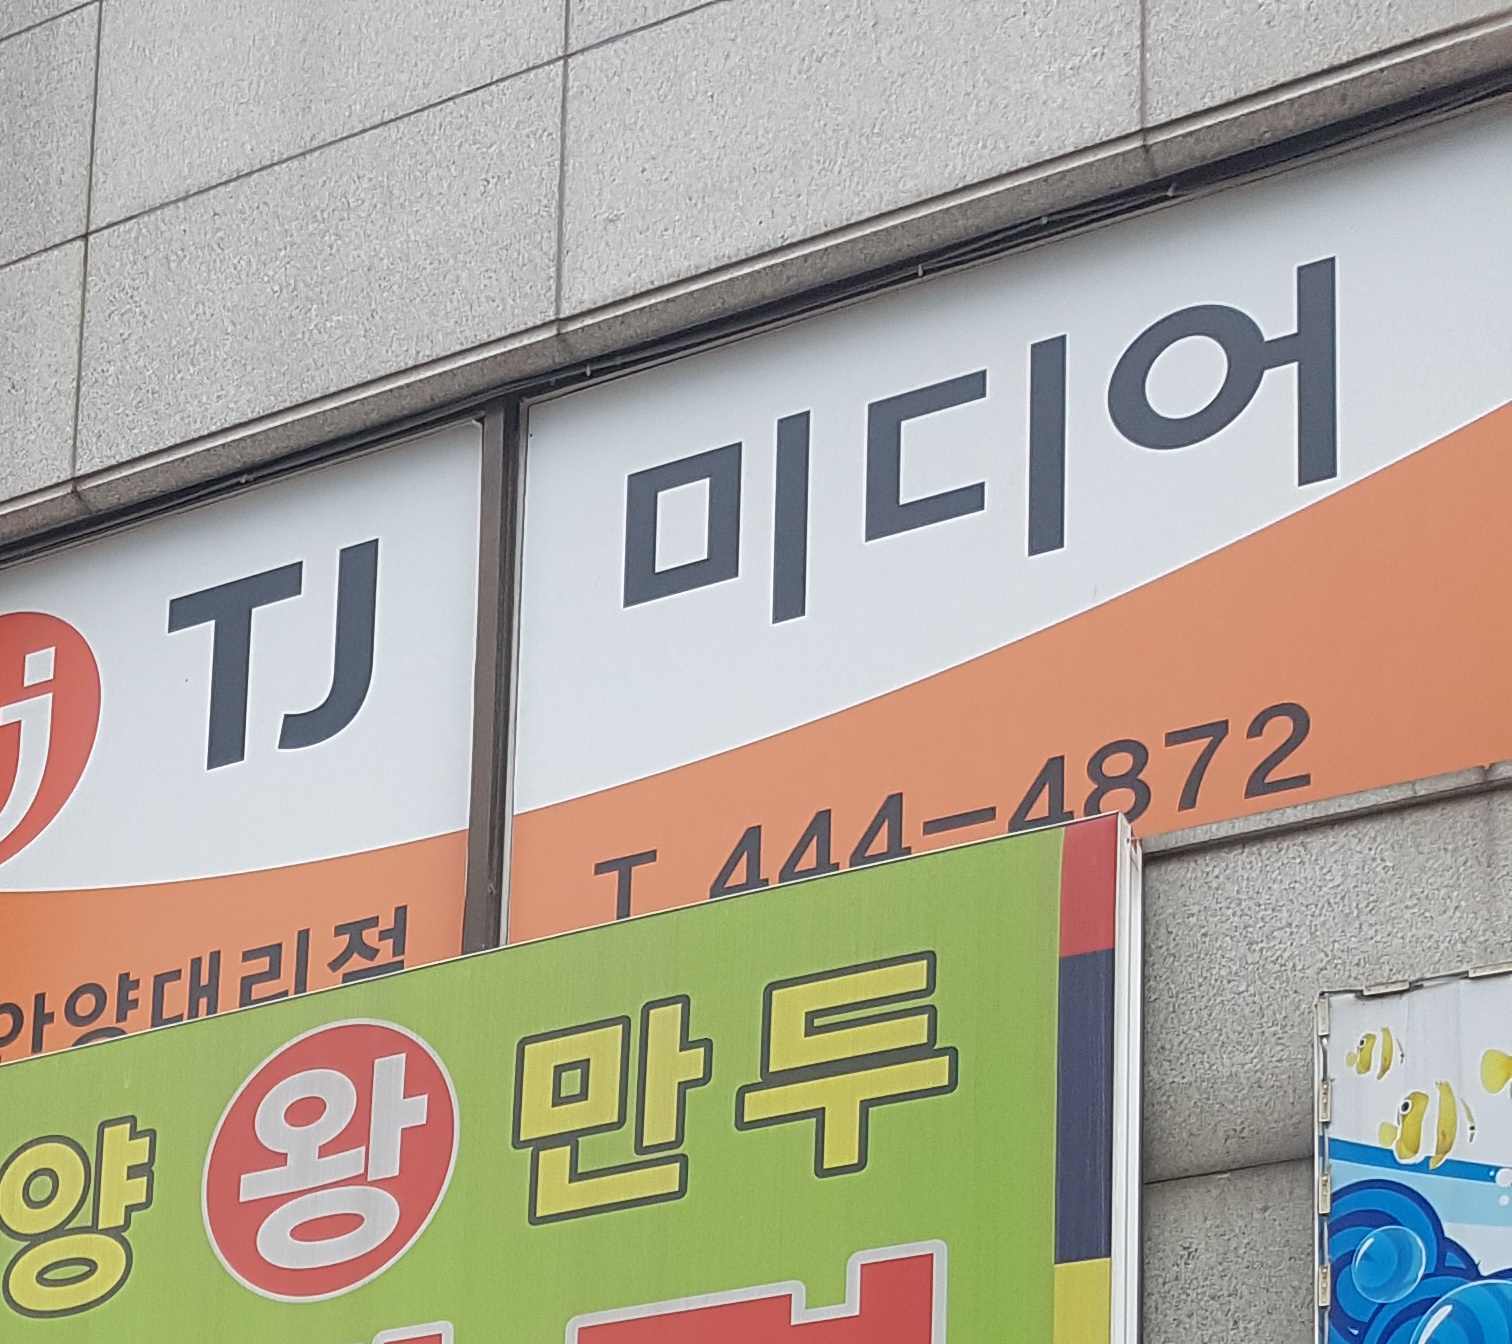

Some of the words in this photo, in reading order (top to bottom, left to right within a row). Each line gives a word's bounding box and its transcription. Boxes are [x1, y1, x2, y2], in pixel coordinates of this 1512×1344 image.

[167, 537, 379, 772] TJ
[622, 255, 1338, 625] 미디어
[708, 702, 1312, 900] 444-4872
[238, 1052, 428, 1270] 왕
[512, 950, 957, 1226] 만두
